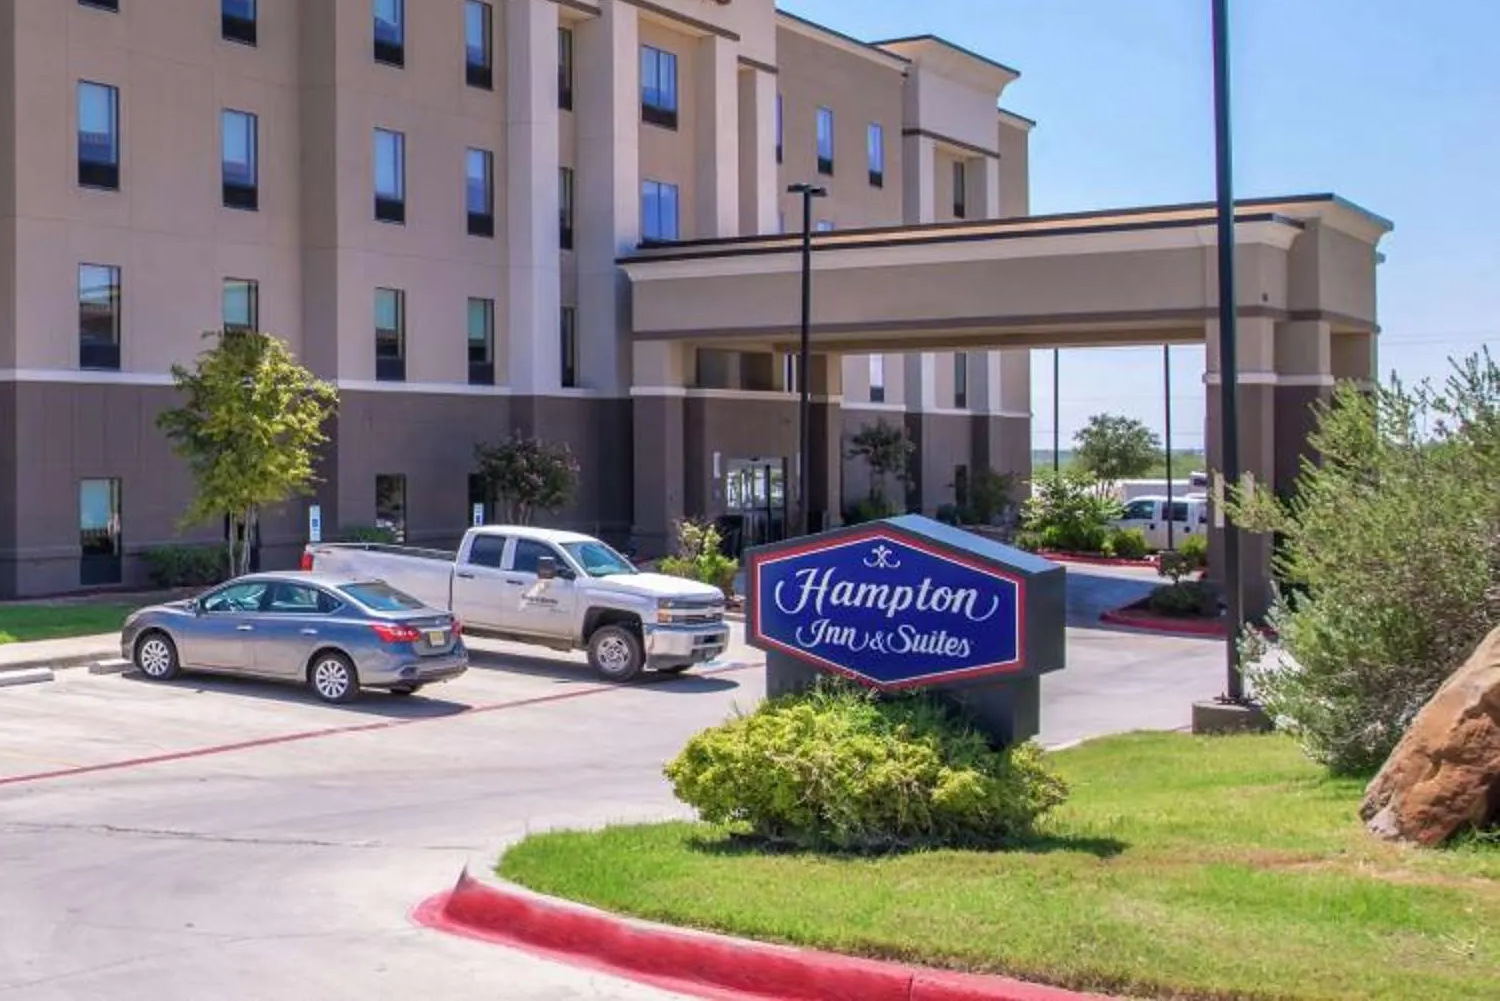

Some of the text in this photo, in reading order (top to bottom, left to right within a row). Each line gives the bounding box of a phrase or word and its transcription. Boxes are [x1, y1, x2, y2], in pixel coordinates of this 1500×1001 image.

[774, 566, 1000, 622] Hampton
[795, 618, 972, 658] Inn & Suites
